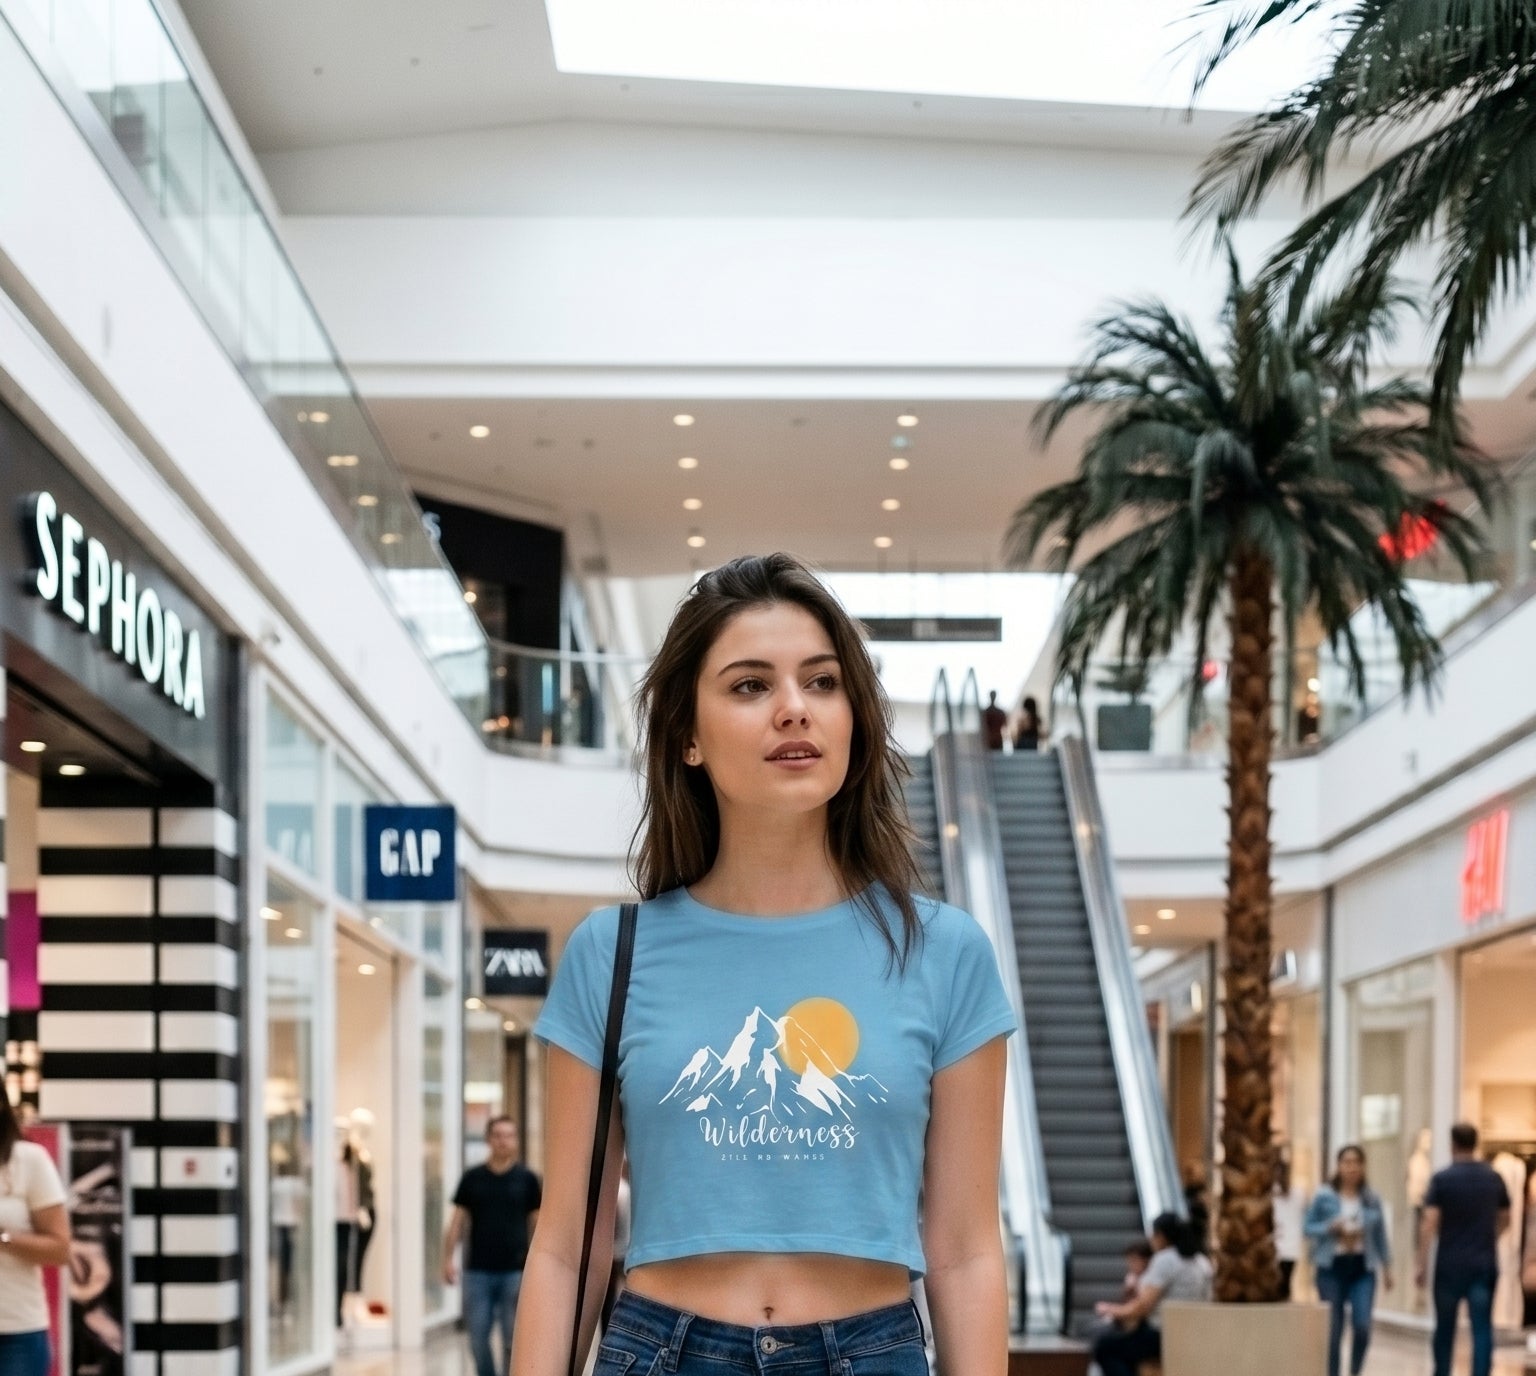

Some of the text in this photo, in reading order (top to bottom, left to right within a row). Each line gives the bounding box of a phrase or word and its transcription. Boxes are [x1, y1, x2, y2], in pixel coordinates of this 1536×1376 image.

[36, 491, 206, 719] SEPHORA
[380, 827, 441, 877] GAP
[700, 1113, 860, 1149] Wilderness
